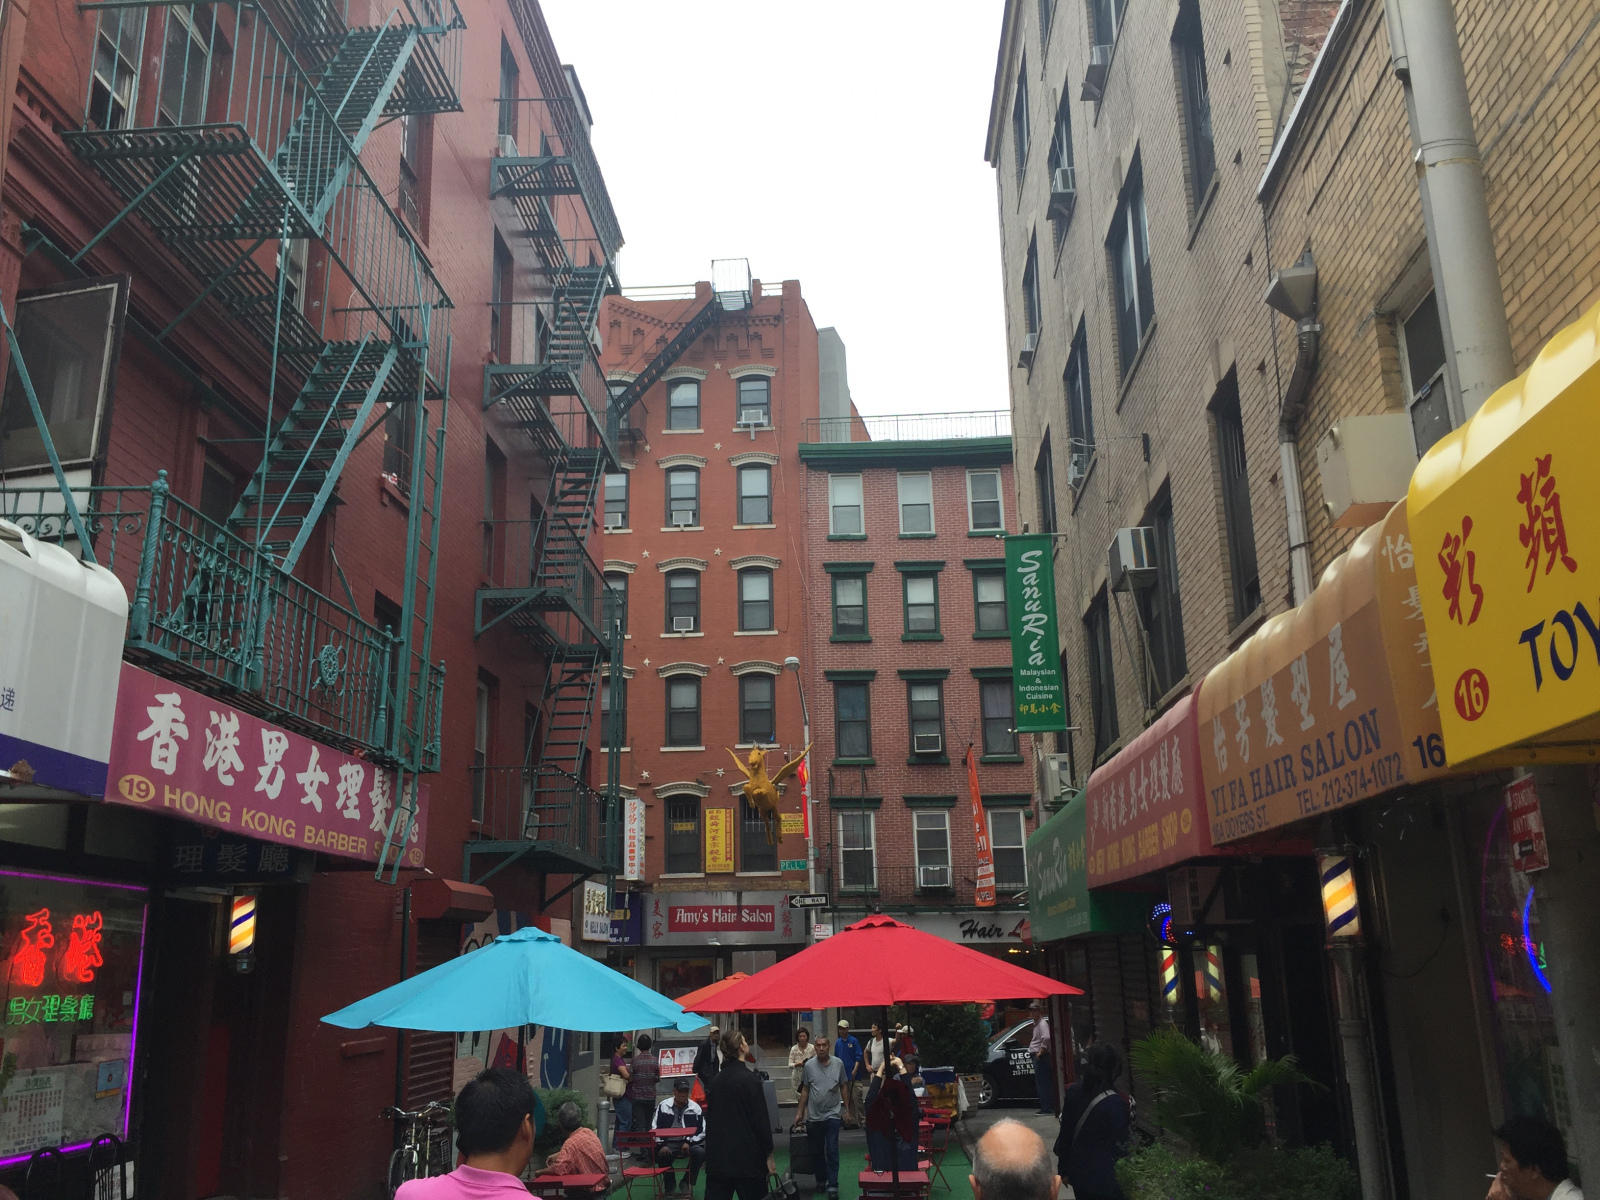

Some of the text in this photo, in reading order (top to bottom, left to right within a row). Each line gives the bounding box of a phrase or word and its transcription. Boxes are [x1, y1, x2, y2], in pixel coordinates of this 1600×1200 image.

[1017, 550, 1048, 665] SanuRia
[1020, 668, 1056, 677] Malaysian
[1018, 684, 1059, 692] Indonesian
[1026, 692, 1053, 700] Cuisine
[1458, 673, 1484, 718] 16
[1211, 708, 1381, 817] YI FA HAIR SALON
[1297, 752, 1404, 815] TEL: 212-374-1072
[124, 778, 150, 797] 19
[163, 785, 231, 824] HONG
[241, 807, 297, 839] KONG
[304, 825, 367, 855] BARBER
[410, 848, 423, 864] 19
[1225, 810, 1255, 840] DOYERS
[1255, 804, 1271, 827] ST.
[780, 861, 800, 870] PELL
[675, 908, 772, 925] Amy's Hair Salon
[959, 919, 1004, 939] Hair
